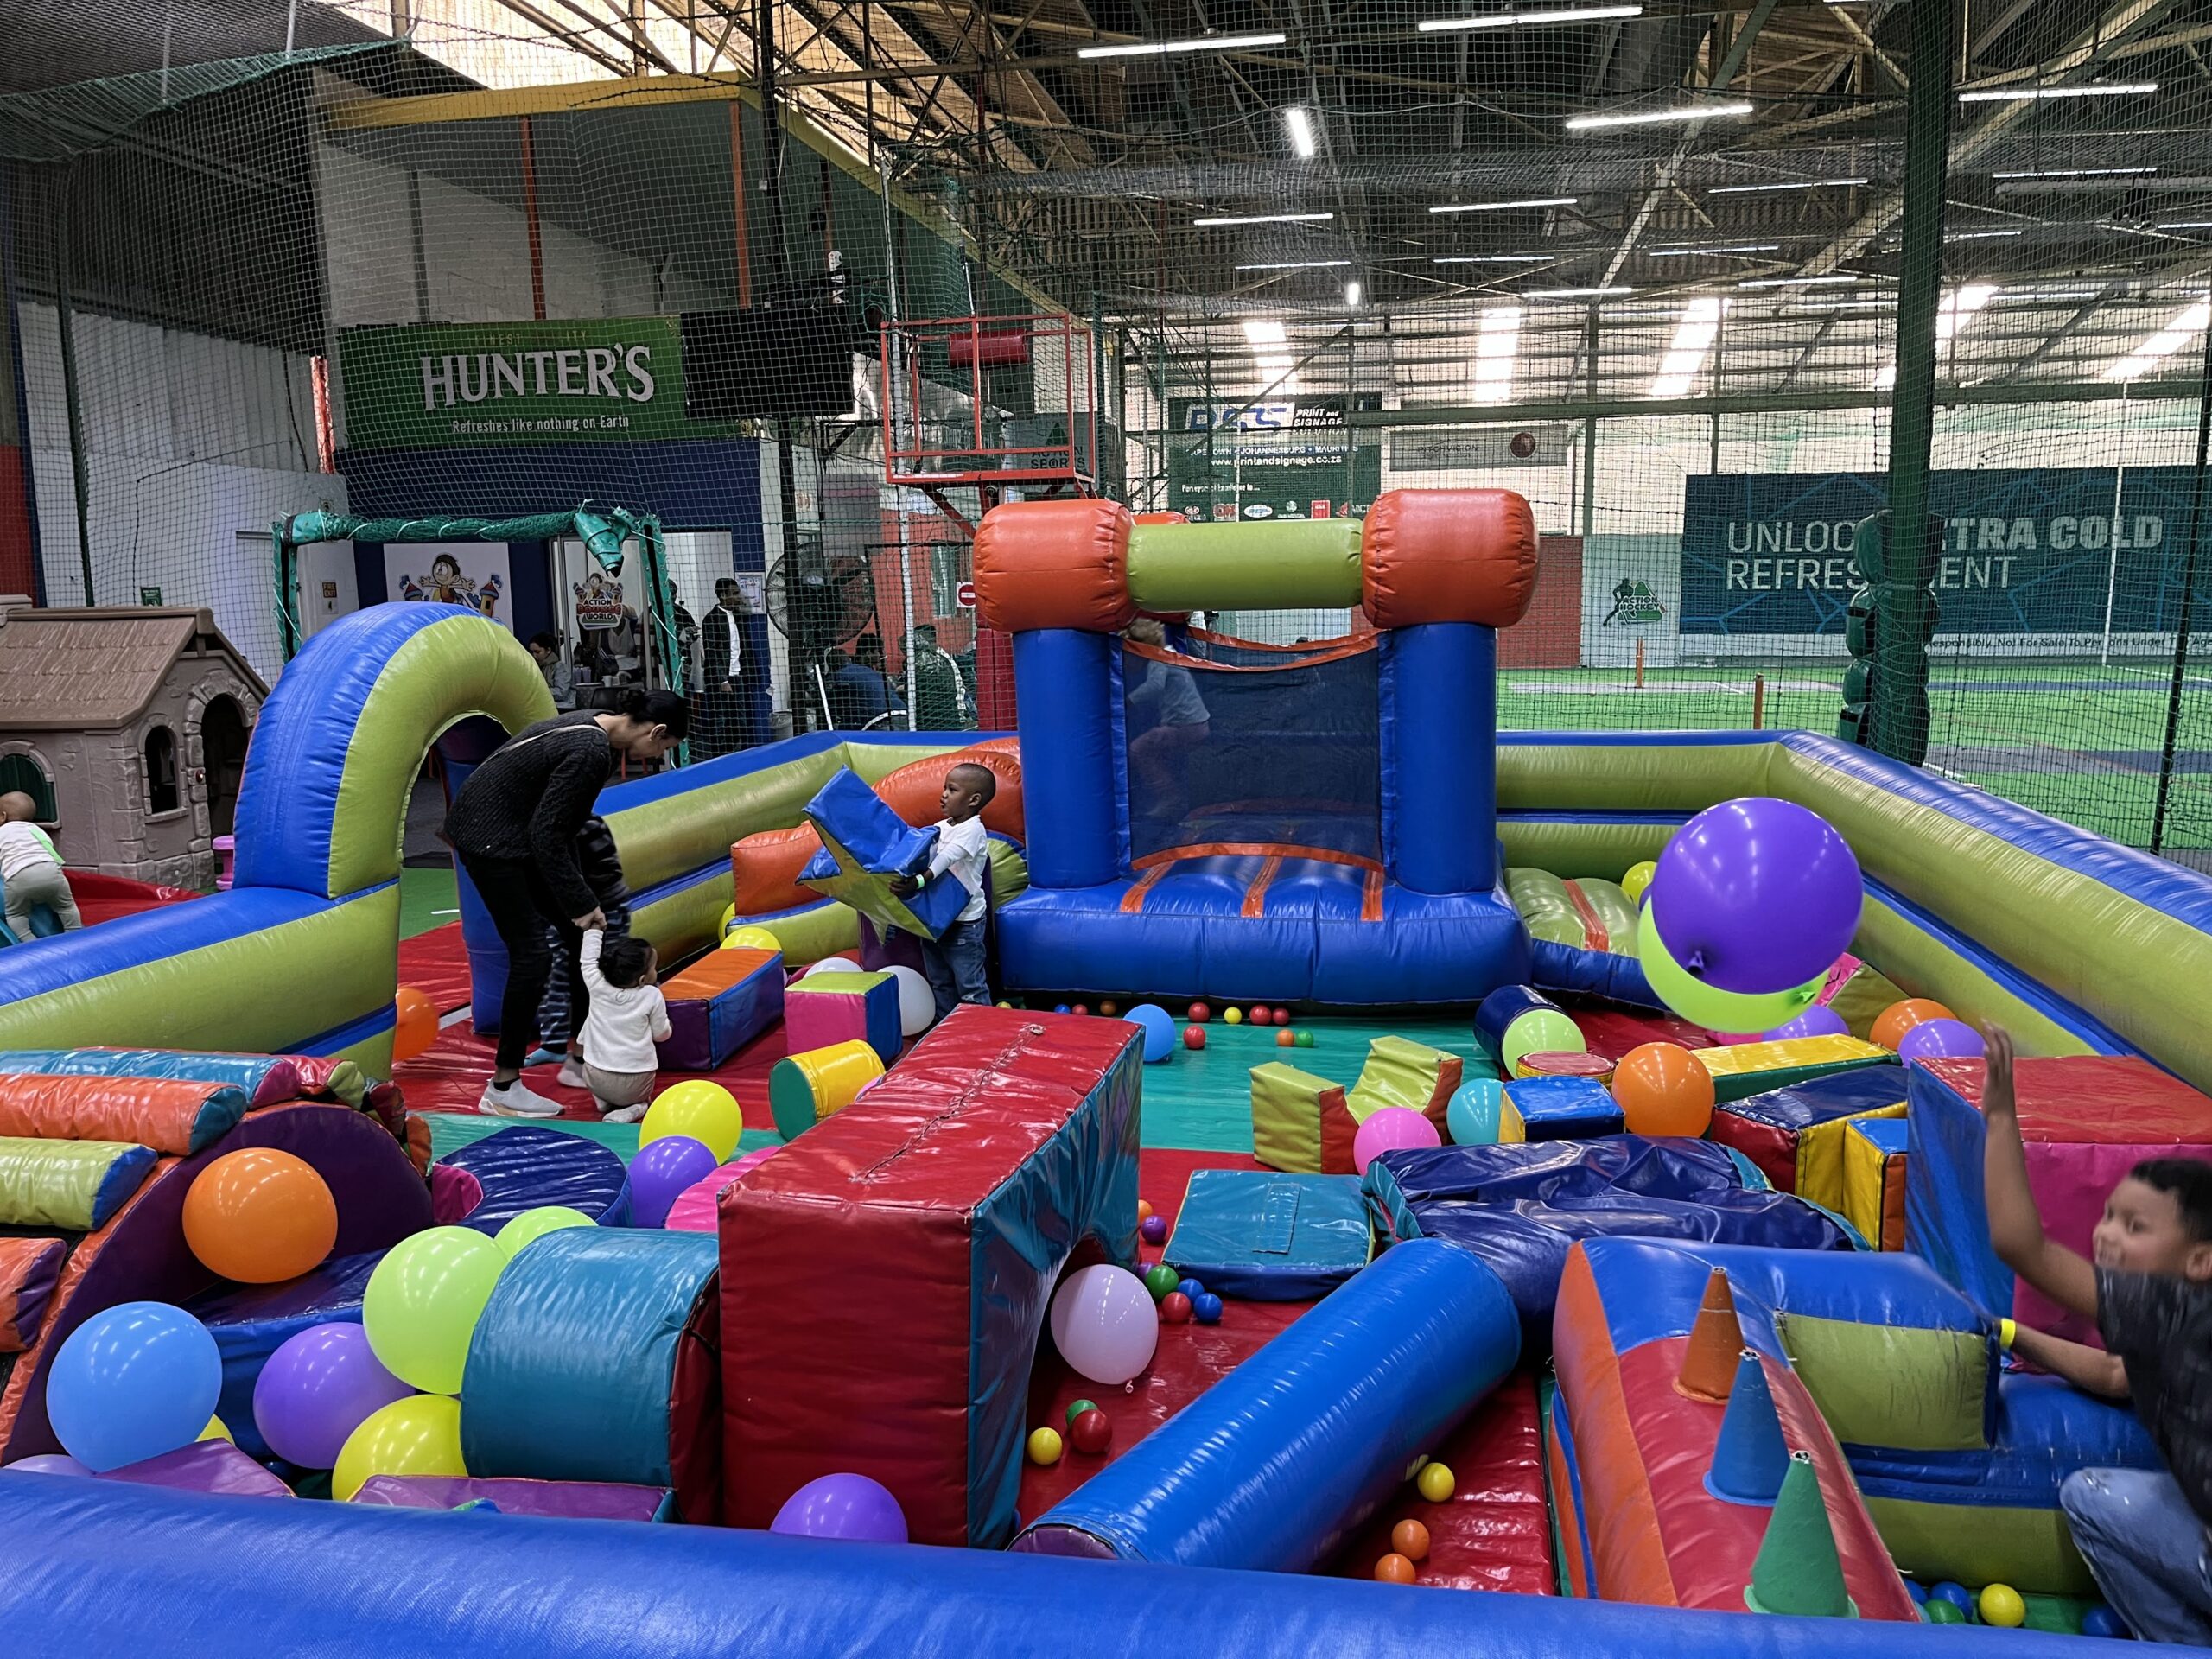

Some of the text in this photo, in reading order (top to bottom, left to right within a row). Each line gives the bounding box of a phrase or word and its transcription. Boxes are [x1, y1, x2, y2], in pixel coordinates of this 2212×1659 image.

[421, 343, 655, 411] HUNTER'S
[1295, 408, 1326, 417] PRINT
[453, 420, 508, 433] Refreshes
[512, 418, 532, 431] like
[537, 416, 579, 431] nothing
[583, 417, 596, 429] on
[1240, 446, 1306, 455] JOHANNESBURG
[1031, 457, 1085, 469] SPORS
[1728, 520, 1854, 553] UNLOC
[2049, 516, 2162, 550] COLD
[1726, 557, 2017, 590] REFRESENT
[2085, 638, 2128, 647] Perons
